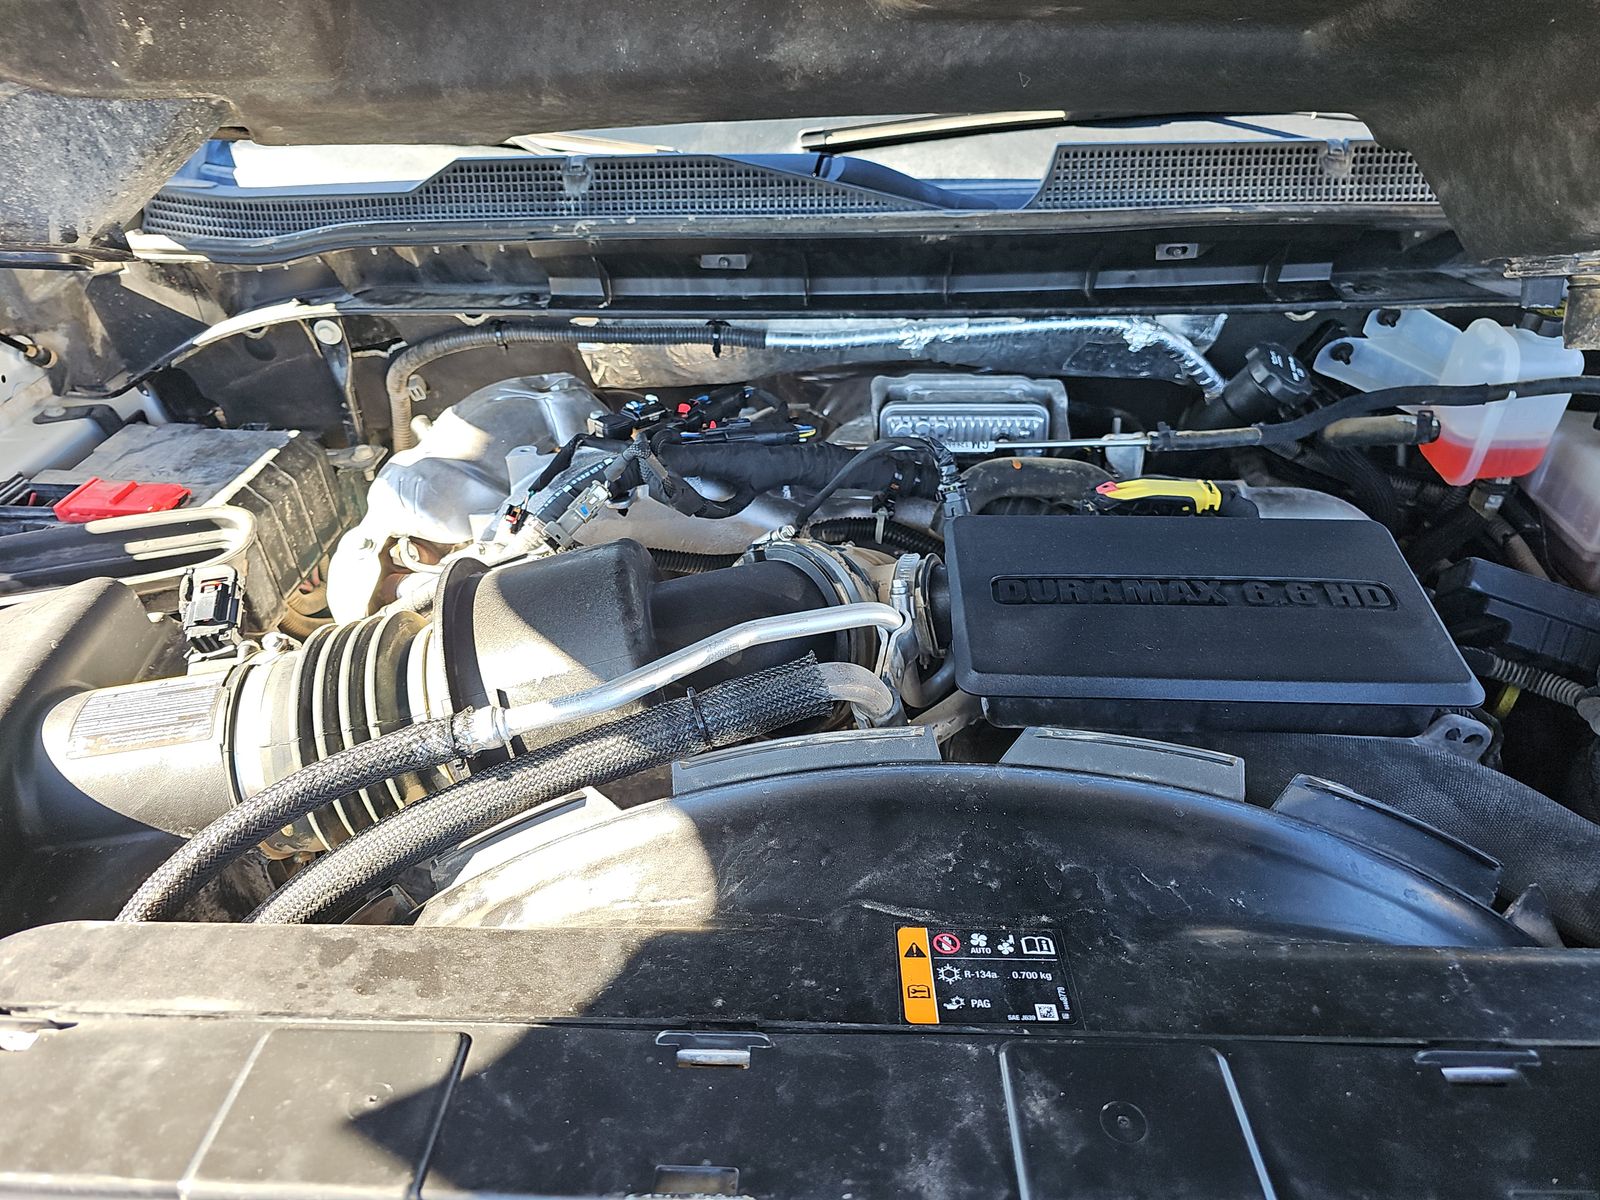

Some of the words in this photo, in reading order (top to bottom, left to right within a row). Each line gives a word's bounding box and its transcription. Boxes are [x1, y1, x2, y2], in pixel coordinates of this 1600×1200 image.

[997, 578, 1229, 603] DURAMAX
[1243, 580, 1318, 605] 6.6
[1323, 583, 1391, 607] HD
[964, 970, 998, 978] R-134a
[1012, 971, 1038, 979] 0.700
[1039, 971, 1052, 980] kg
[970, 999, 991, 1008] PAG
